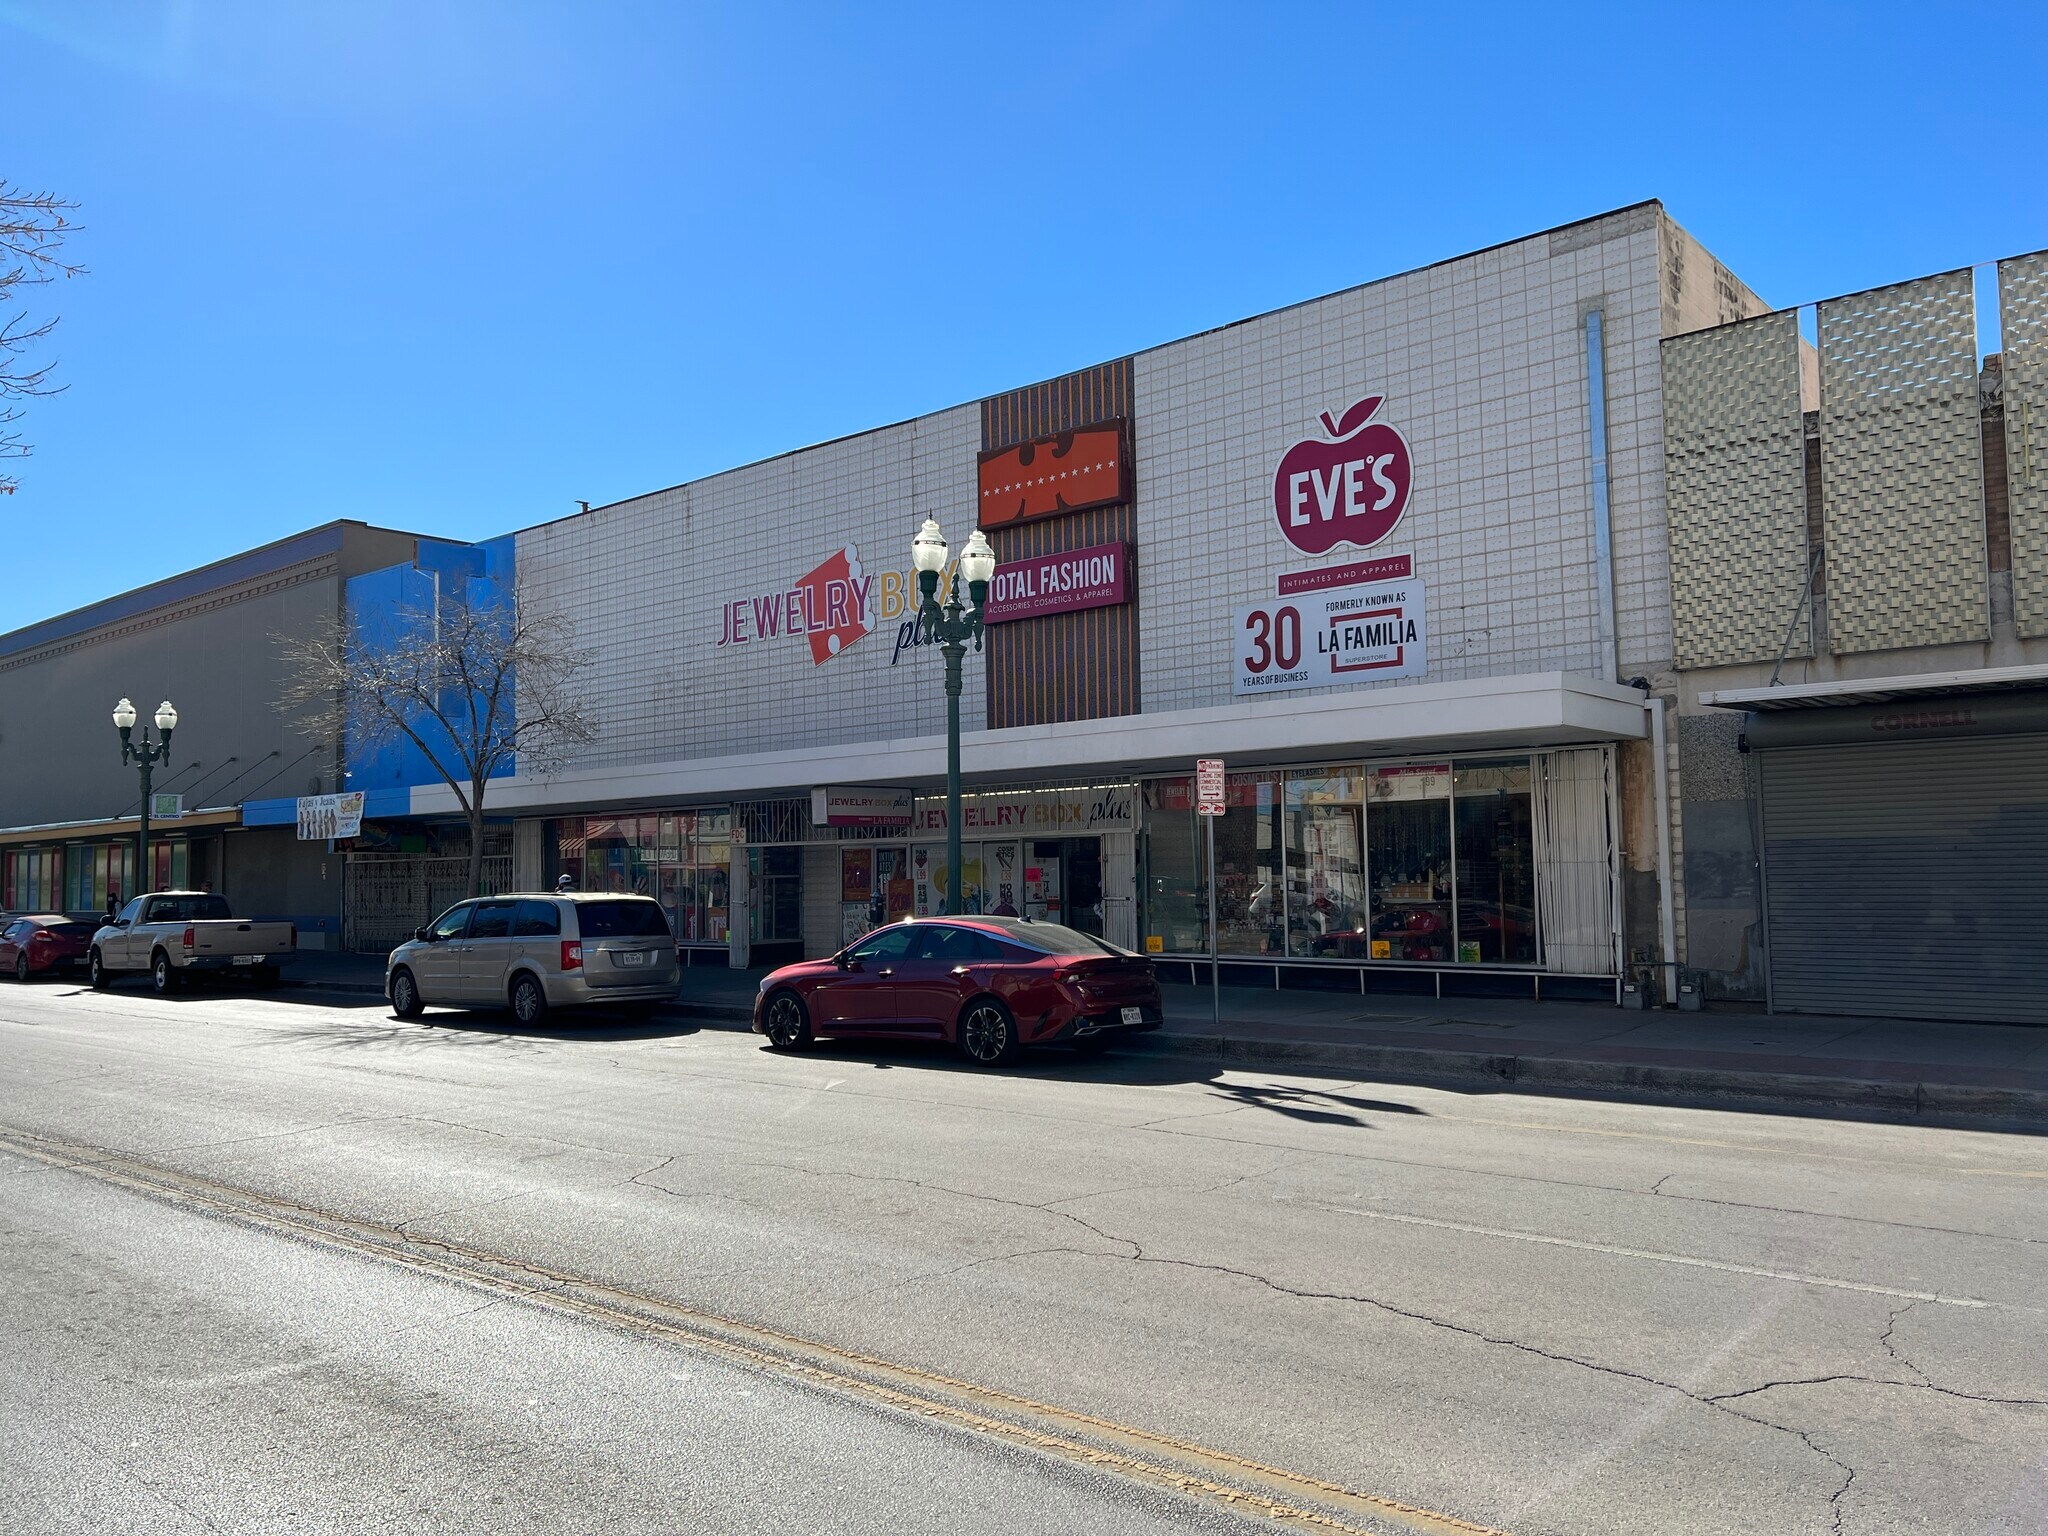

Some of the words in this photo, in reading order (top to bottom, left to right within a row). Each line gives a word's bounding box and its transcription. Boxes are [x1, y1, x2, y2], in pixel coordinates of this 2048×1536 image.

[989, 569, 1037, 604] TOTAL
[1040, 554, 1116, 595] FASHION
[1283, 574, 1332, 588] INTIMATES
[1337, 570, 1357, 580] AND
[1362, 563, 1406, 576] APPAREL
[1083, 588, 1113, 599] APPAREL
[1325, 598, 1364, 612] FORMERLY
[1365, 594, 1395, 609] KNOWN
[1396, 592, 1406, 602] AS
[717, 573, 874, 648] JEWELRY
[1245, 606, 1302, 673] 30
[1318, 626, 1339, 654] LA
[1345, 619, 1418, 650] FAMILIA
[1345, 653, 1388, 664] SUPERSTORE
[1871, 709, 1978, 731] CORNELL
[1231, 771, 1280, 787] COSMETICS
[1291, 767, 1325, 778] EYELASHES
[319, 796, 336, 807] Jeans
[829, 798, 874, 807] JEWELRY
[875, 799, 893, 807] BOX
[883, 816, 911, 825] FAMILIA
[1034, 802, 1086, 824] BOX
[731, 829, 745, 839] FDC
